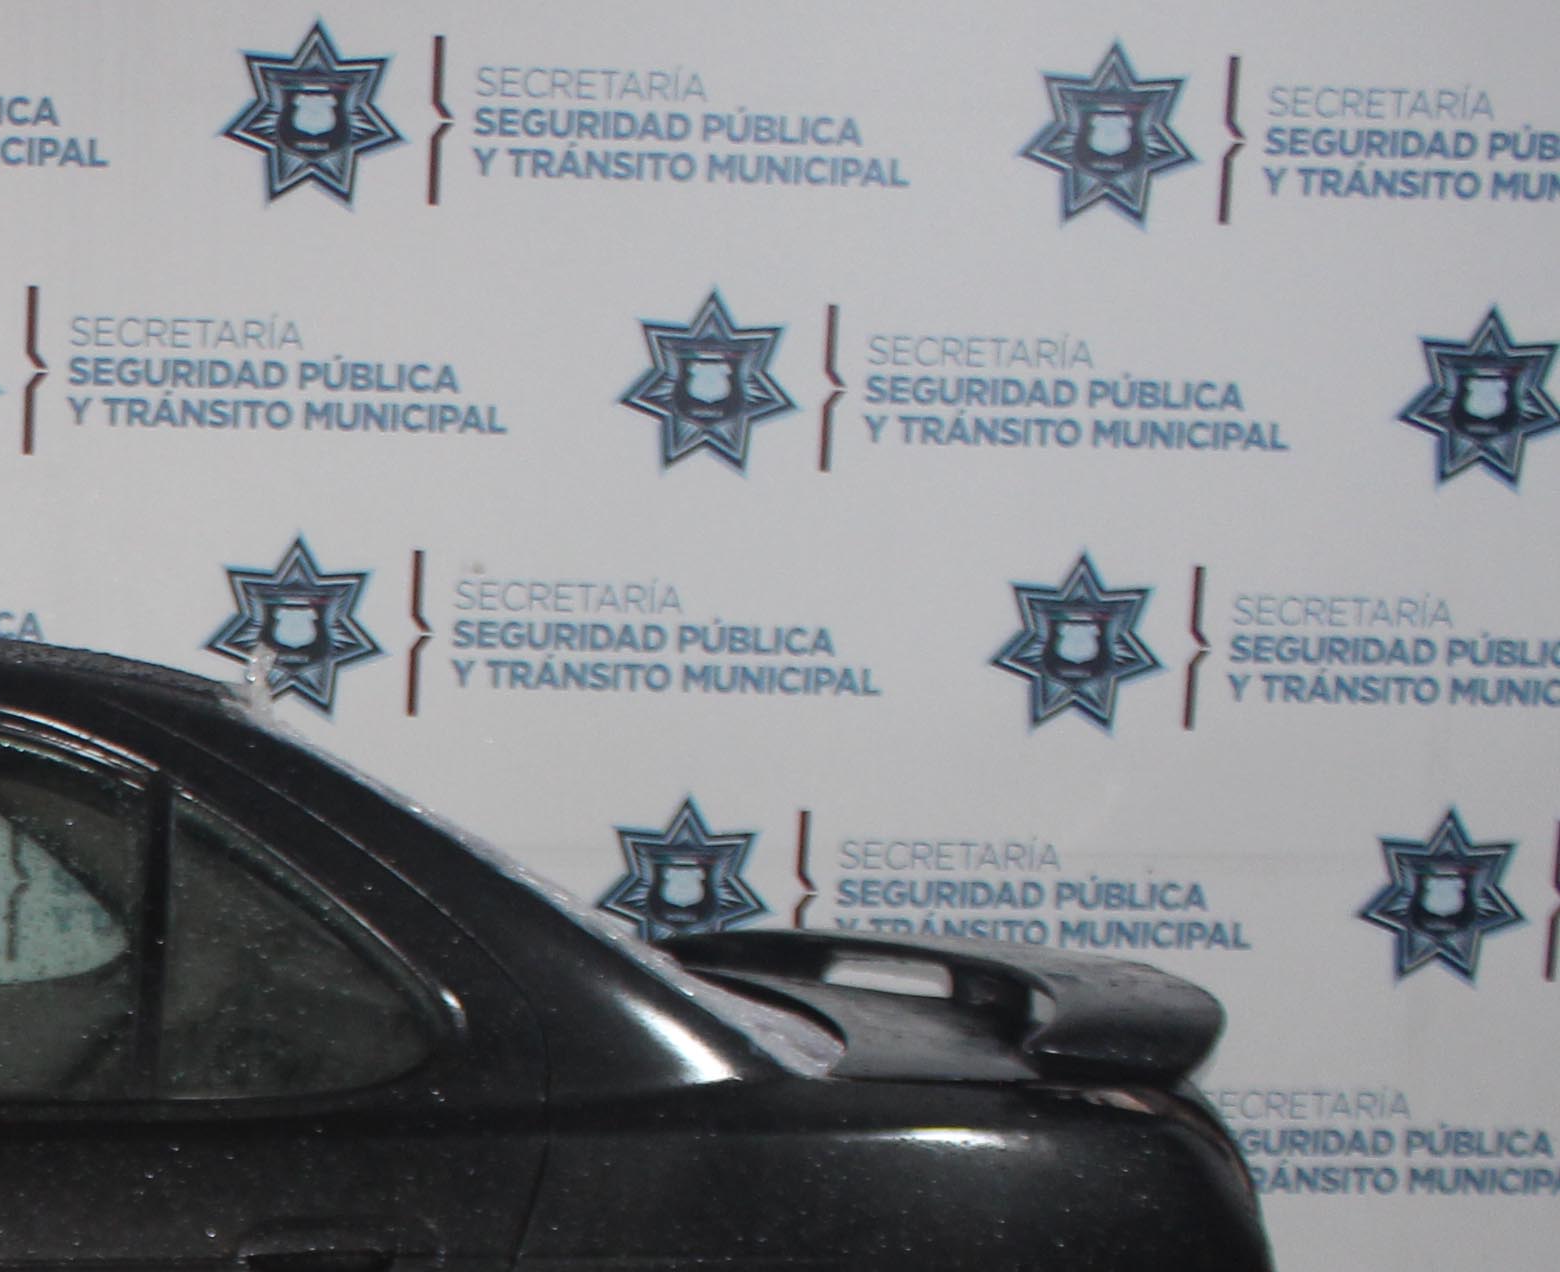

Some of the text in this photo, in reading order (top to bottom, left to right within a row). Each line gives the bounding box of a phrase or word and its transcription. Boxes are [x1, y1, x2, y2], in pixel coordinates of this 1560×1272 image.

[475, 65, 707, 102] SECRETARÍA
[1268, 84, 1495, 121] SECRETARÍA
[473, 106, 862, 145] SEGURIDAD PÚBLICA
[1265, 127, 1479, 158] SEGURIDAD
[473, 141, 910, 187] Y TRÁNSITO MUNICIPAL
[1264, 168, 1285, 197] Y
[1297, 162, 1482, 199] TRÁNSITO
[69, 313, 303, 350] SECRETARÍA
[865, 333, 1095, 369] SECRETARÍA
[68, 353, 460, 393] SEGURIDAD PÚBLICA
[865, 372, 1245, 411] SEGURIDAD PÚBLICA
[66, 390, 508, 434] Y TRÁNSITO MUNICIPAL
[863, 409, 1290, 451] Y TRÁNSITO MUNICIPAL
[453, 578, 683, 614] SECRETARÍA
[1232, 593, 1455, 628] SECRETARÍA
[453, 617, 835, 656] SEGURIDAD PÚBLICA
[1230, 634, 1438, 666] SEGURIDAD
[451, 654, 882, 696] Y TRÁNSITO MUNICIPAL
[1227, 673, 1252, 702] Y
[1261, 668, 1441, 705] TRÁNSITO
[838, 837, 1061, 871] SECRETARÍA
[837, 875, 1208, 911] SEGURIDAD PÚBLICA
[1059, 919, 1253, 951] MUNICIPAL
[1406, 1123, 1556, 1159] PÚBLICA
